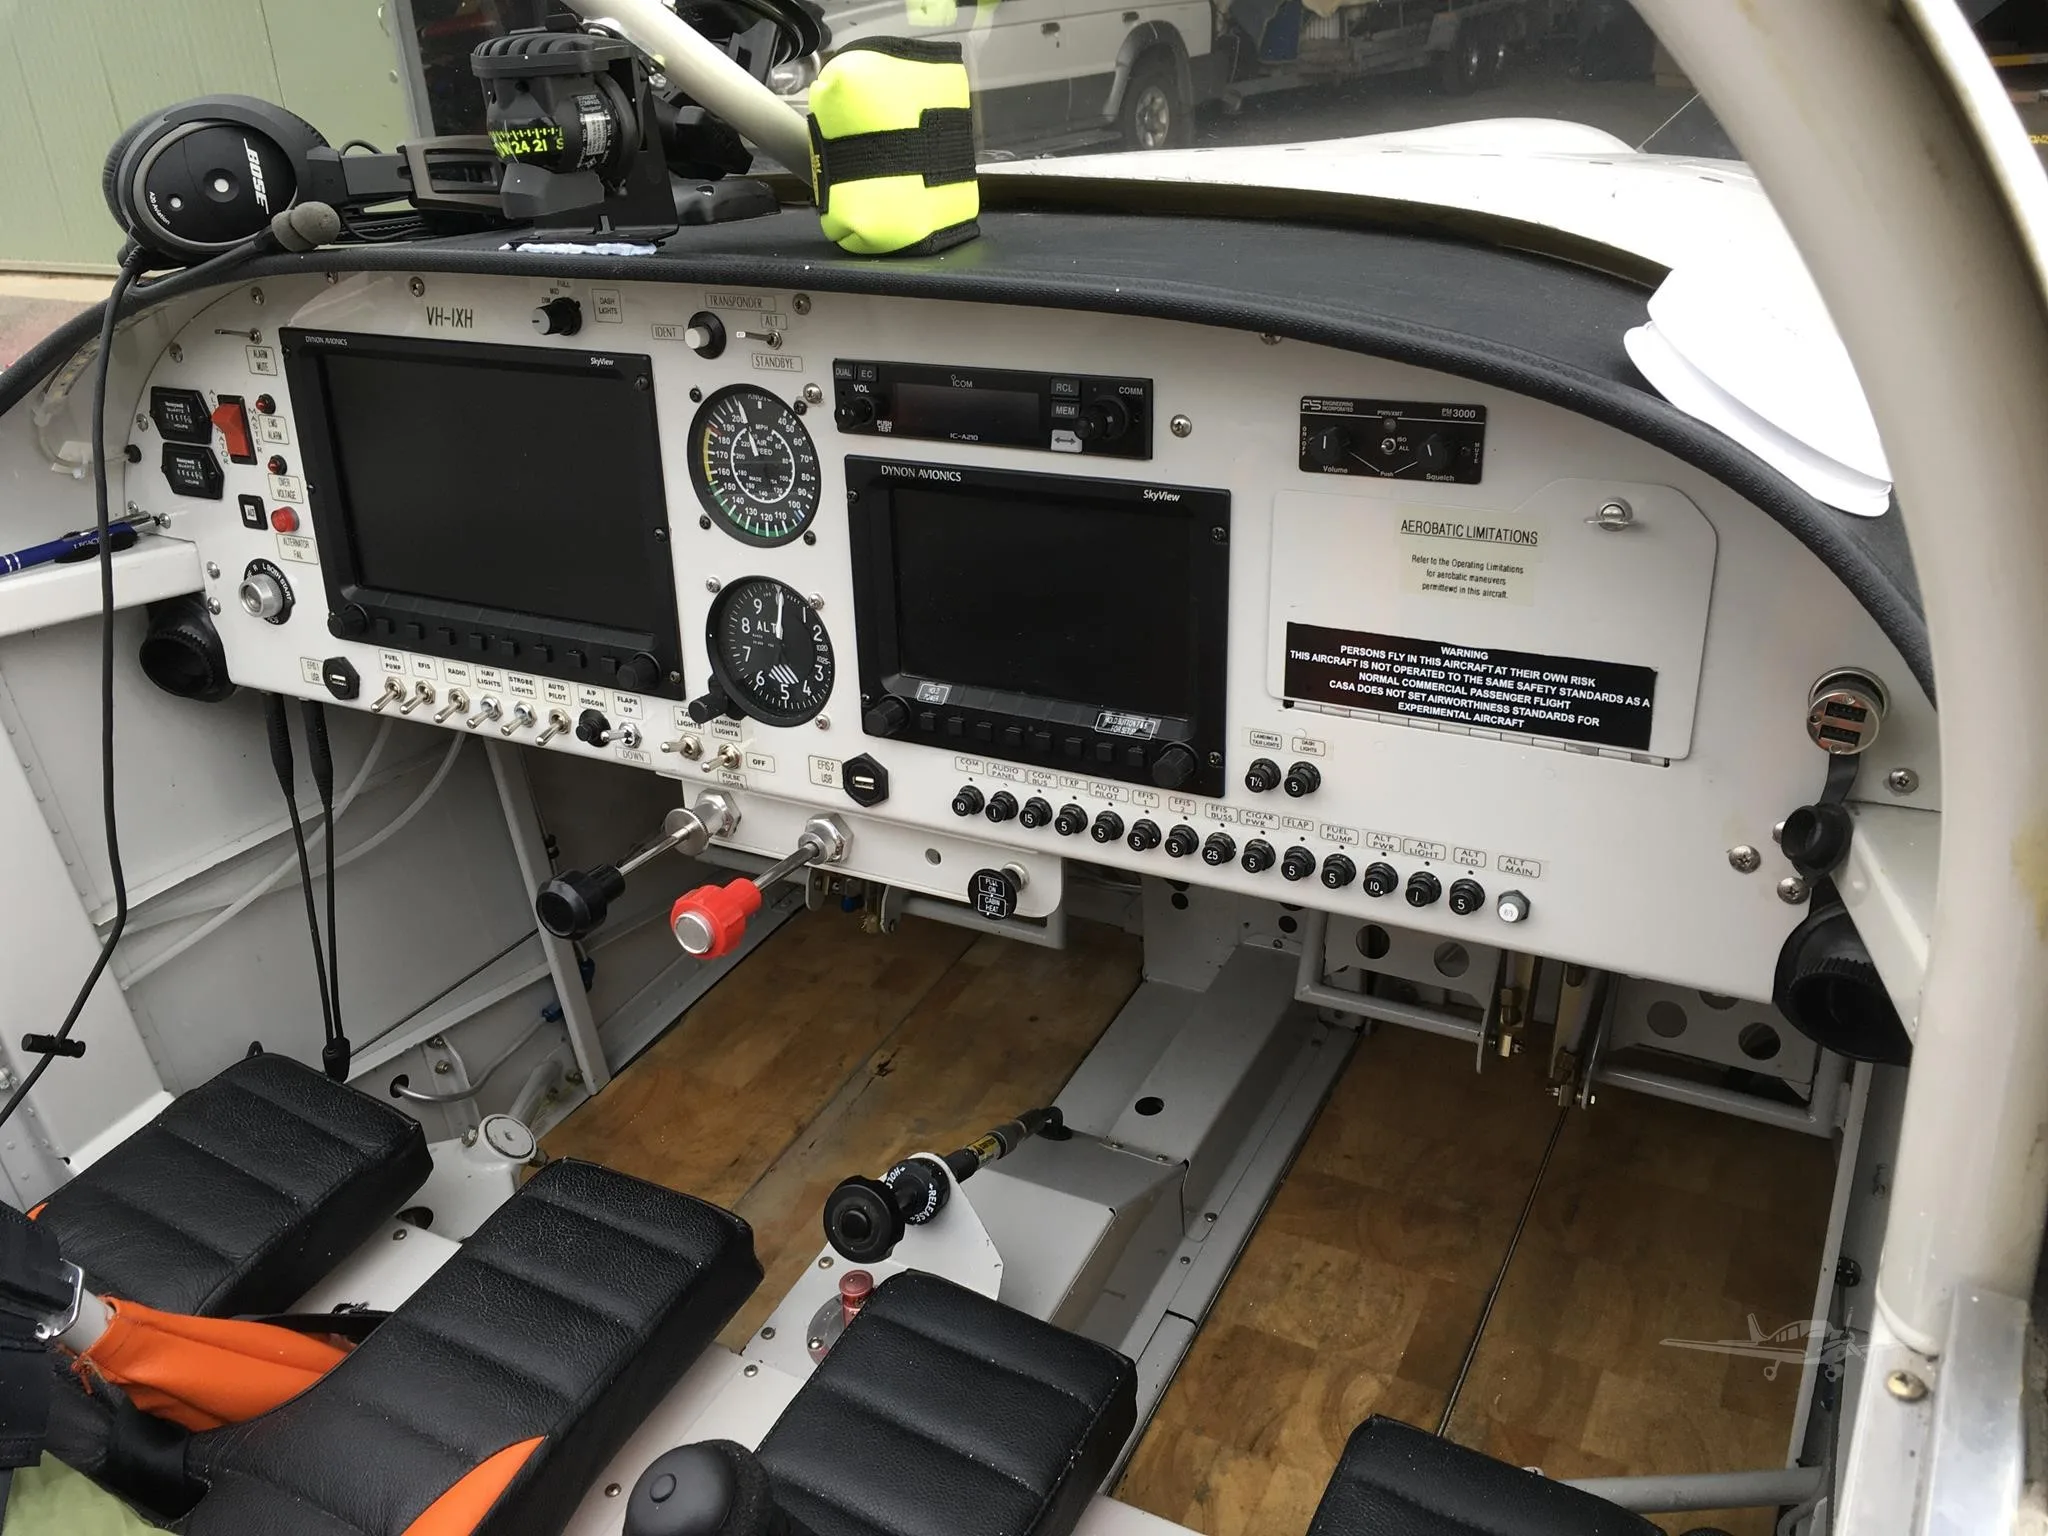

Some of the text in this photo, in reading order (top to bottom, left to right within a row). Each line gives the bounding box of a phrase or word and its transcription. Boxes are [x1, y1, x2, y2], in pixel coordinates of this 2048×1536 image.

[511, 138, 564, 154] 24 21 S
[243, 138, 269, 214] BOSE
[152, 203, 171, 225] Aviation
[709, 296, 763, 309] TRANSPONDER
[426, 306, 473, 328] VH-IXH
[765, 315, 778, 326] ALT
[655, 327, 676, 338] IDENT
[590, 357, 614, 367] SkyView
[755, 356, 794, 370] STANDBYE
[836, 368, 872, 378] DUAL EC
[854, 384, 870, 393] VOL
[1056, 383, 1073, 393] RCL
[1118, 386, 1144, 396] COMM
[1056, 406, 1075, 416] MEM
[248, 408, 262, 453] MASTER
[723, 424, 735, 432] 190
[718, 436, 730, 445] 180
[950, 432, 978, 442] IC-A210
[716, 451, 729, 460] 170
[718, 468, 730, 476] 160
[881, 465, 962, 482] DYNON AVIONICS
[1323, 466, 1348, 474] Volume
[1426, 473, 1455, 482] Squelch
[724, 482, 736, 491] 150
[278, 489, 296, 500] VOLTAGE
[1143, 490, 1181, 503] SkyView
[732, 496, 745, 505] 140
[788, 500, 800, 509] 100
[745, 508, 758, 516] 130
[760, 513, 773, 521] 120
[774, 512, 787, 520] 110
[1400, 520, 1538, 545] AEROBATIC LIMITATIONS
[283, 538, 310, 549] ALTERNATOR
[1411, 554, 1524, 574] Refer to the Operating Limitations
[1426, 569, 1507, 586] for aerobatic maneuvers
[280, 579, 292, 600] START
[1459, 583, 1466, 594] in
[1467, 585, 1481, 596] this
[1482, 588, 1508, 599] aircraft.
[754, 598, 763, 614] 9
[741, 617, 750, 634] 8
[757, 620, 777, 634] ALT
[812, 624, 823, 642] 2
[384, 654, 399, 662] FUEL
[743, 646, 751, 662] 7
[1441, 646, 1489, 660] WARNING
[385, 662, 401, 671] PUMP
[418, 662, 431, 670] EFIS
[1340, 645, 1596, 687] PERSONS FLY IN THIS AIRCRAFT AT THEIR OWN RISK
[448, 668, 466, 677] RADIO
[481, 670, 495, 678] NAV
[815, 664, 824, 682] 3
[477, 678, 501, 688] LIGHTS
[508, 676, 534, 686] STROBE
[756, 670, 765, 686] 6
[1290, 650, 1650, 708] THIS AIRCRAFT IS NOT OPERATED TO THE SAME SAFETY STANDARDS AS A
[512, 686, 534, 695] LIGHTS
[548, 683, 564, 691] AUTO
[780, 684, 790, 700] 5
[803, 680, 812, 696] 4
[1359, 672, 1571, 710] NORMAL COMMERCIAL PASSENGER FLIGHT
[548, 692, 566, 701] PILOT
[617, 696, 638, 705] FLAPS
[580, 698, 604, 708] DISCON
[1329, 680, 1600, 727] CASA DOES NOT SET AIRWORTHINESS STANDARDS FOR
[1398, 702, 1524, 728] EXPERIMENTAL AIRCRAFT
[623, 750, 644, 762] DOWN
[960, 758, 978, 767] COM
[992, 763, 1019, 774] AUDIO
[722, 772, 740, 780] PULSE
[992, 770, 1016, 781] PANEL
[1032, 772, 1052, 780] COM
[1065, 778, 1080, 786] TXP
[1291, 782, 1298, 792] 5
[1095, 784, 1120, 794] AUTO
[1095, 790, 1118, 800] PILOT
[1138, 792, 1154, 800] EFIS
[957, 802, 965, 811] 10
[1174, 799, 1191, 807] EFIS
[1024, 814, 1033, 824] 15
[1211, 813, 1233, 822] BUSS
[1246, 812, 1274, 821] CIGAR
[1061, 822, 1067, 831] 5
[1246, 819, 1265, 827] PWR
[1287, 820, 1309, 829] FLAP
[1098, 828, 1104, 838] 5
[1327, 826, 1348, 835] FUEL
[1134, 836, 1141, 847] 5
[1327, 834, 1352, 843] PUMP
[1374, 835, 1392, 843] ALT
[1172, 842, 1178, 853] 5
[1373, 841, 1394, 850] PWR
[1417, 842, 1435, 850] ALT
[1206, 850, 1218, 860] 25
[1410, 848, 1439, 859] LIGHT
[1461, 850, 1480, 858] ALT
[1249, 858, 1256, 868] 5
[1461, 857, 1479, 866] FLD
[1506, 859, 1524, 867] ALT
[1289, 866, 1295, 876] 5
[1506, 866, 1533, 876] MAIN
[1329, 874, 1336, 884] 5
[1370, 881, 1380, 891] 10
[985, 897, 1000, 906] CABIN
[1458, 900, 1465, 910] 5
[986, 904, 999, 913] HEAT
[915, 1190, 937, 1222] RELEASE
